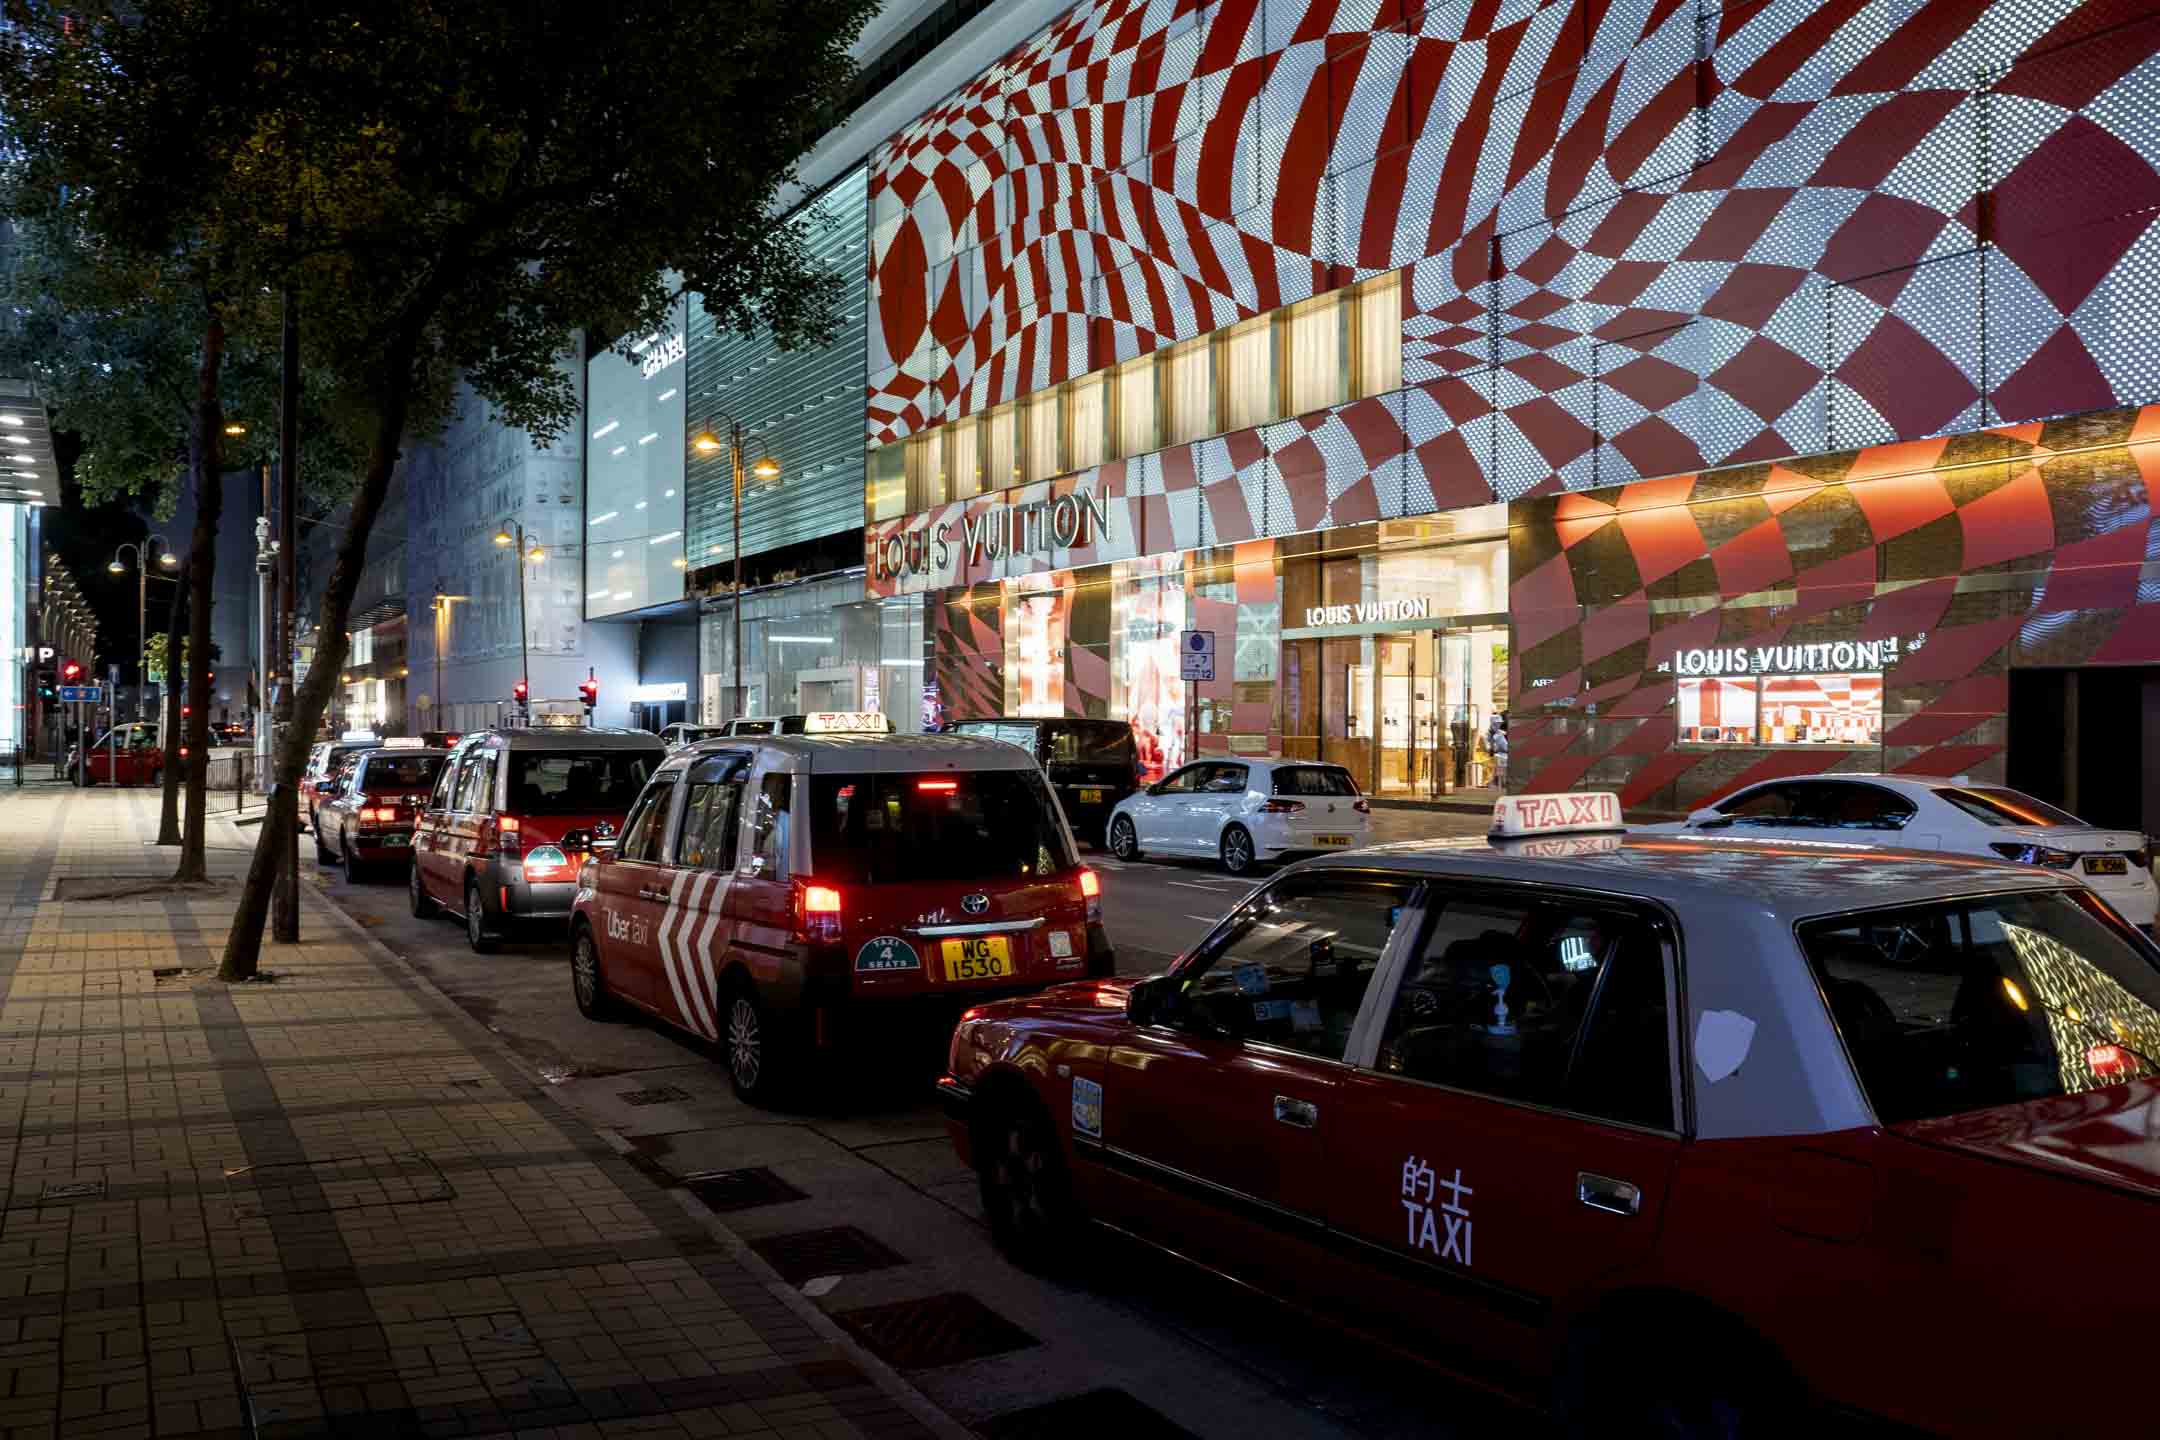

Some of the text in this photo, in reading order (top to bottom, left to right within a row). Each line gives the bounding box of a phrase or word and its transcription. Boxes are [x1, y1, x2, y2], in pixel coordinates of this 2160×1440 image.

[874, 485, 1115, 581] LOUIS VUITTON
[1306, 598, 1431, 626] LOUIS VUITTON
[1675, 649, 1748, 674] LOUIS
[1756, 640, 1880, 672] VUITTON
[818, 714, 880, 728] TAXI
[1516, 795, 1613, 828] TAXI
[607, 911, 629, 941] Uber
[880, 947, 894, 961] 4
[961, 940, 990, 960] WG
[953, 958, 1002, 979] 1530
[1402, 1155, 1472, 1217] 的士
[1401, 1199, 1472, 1267] TAXI
